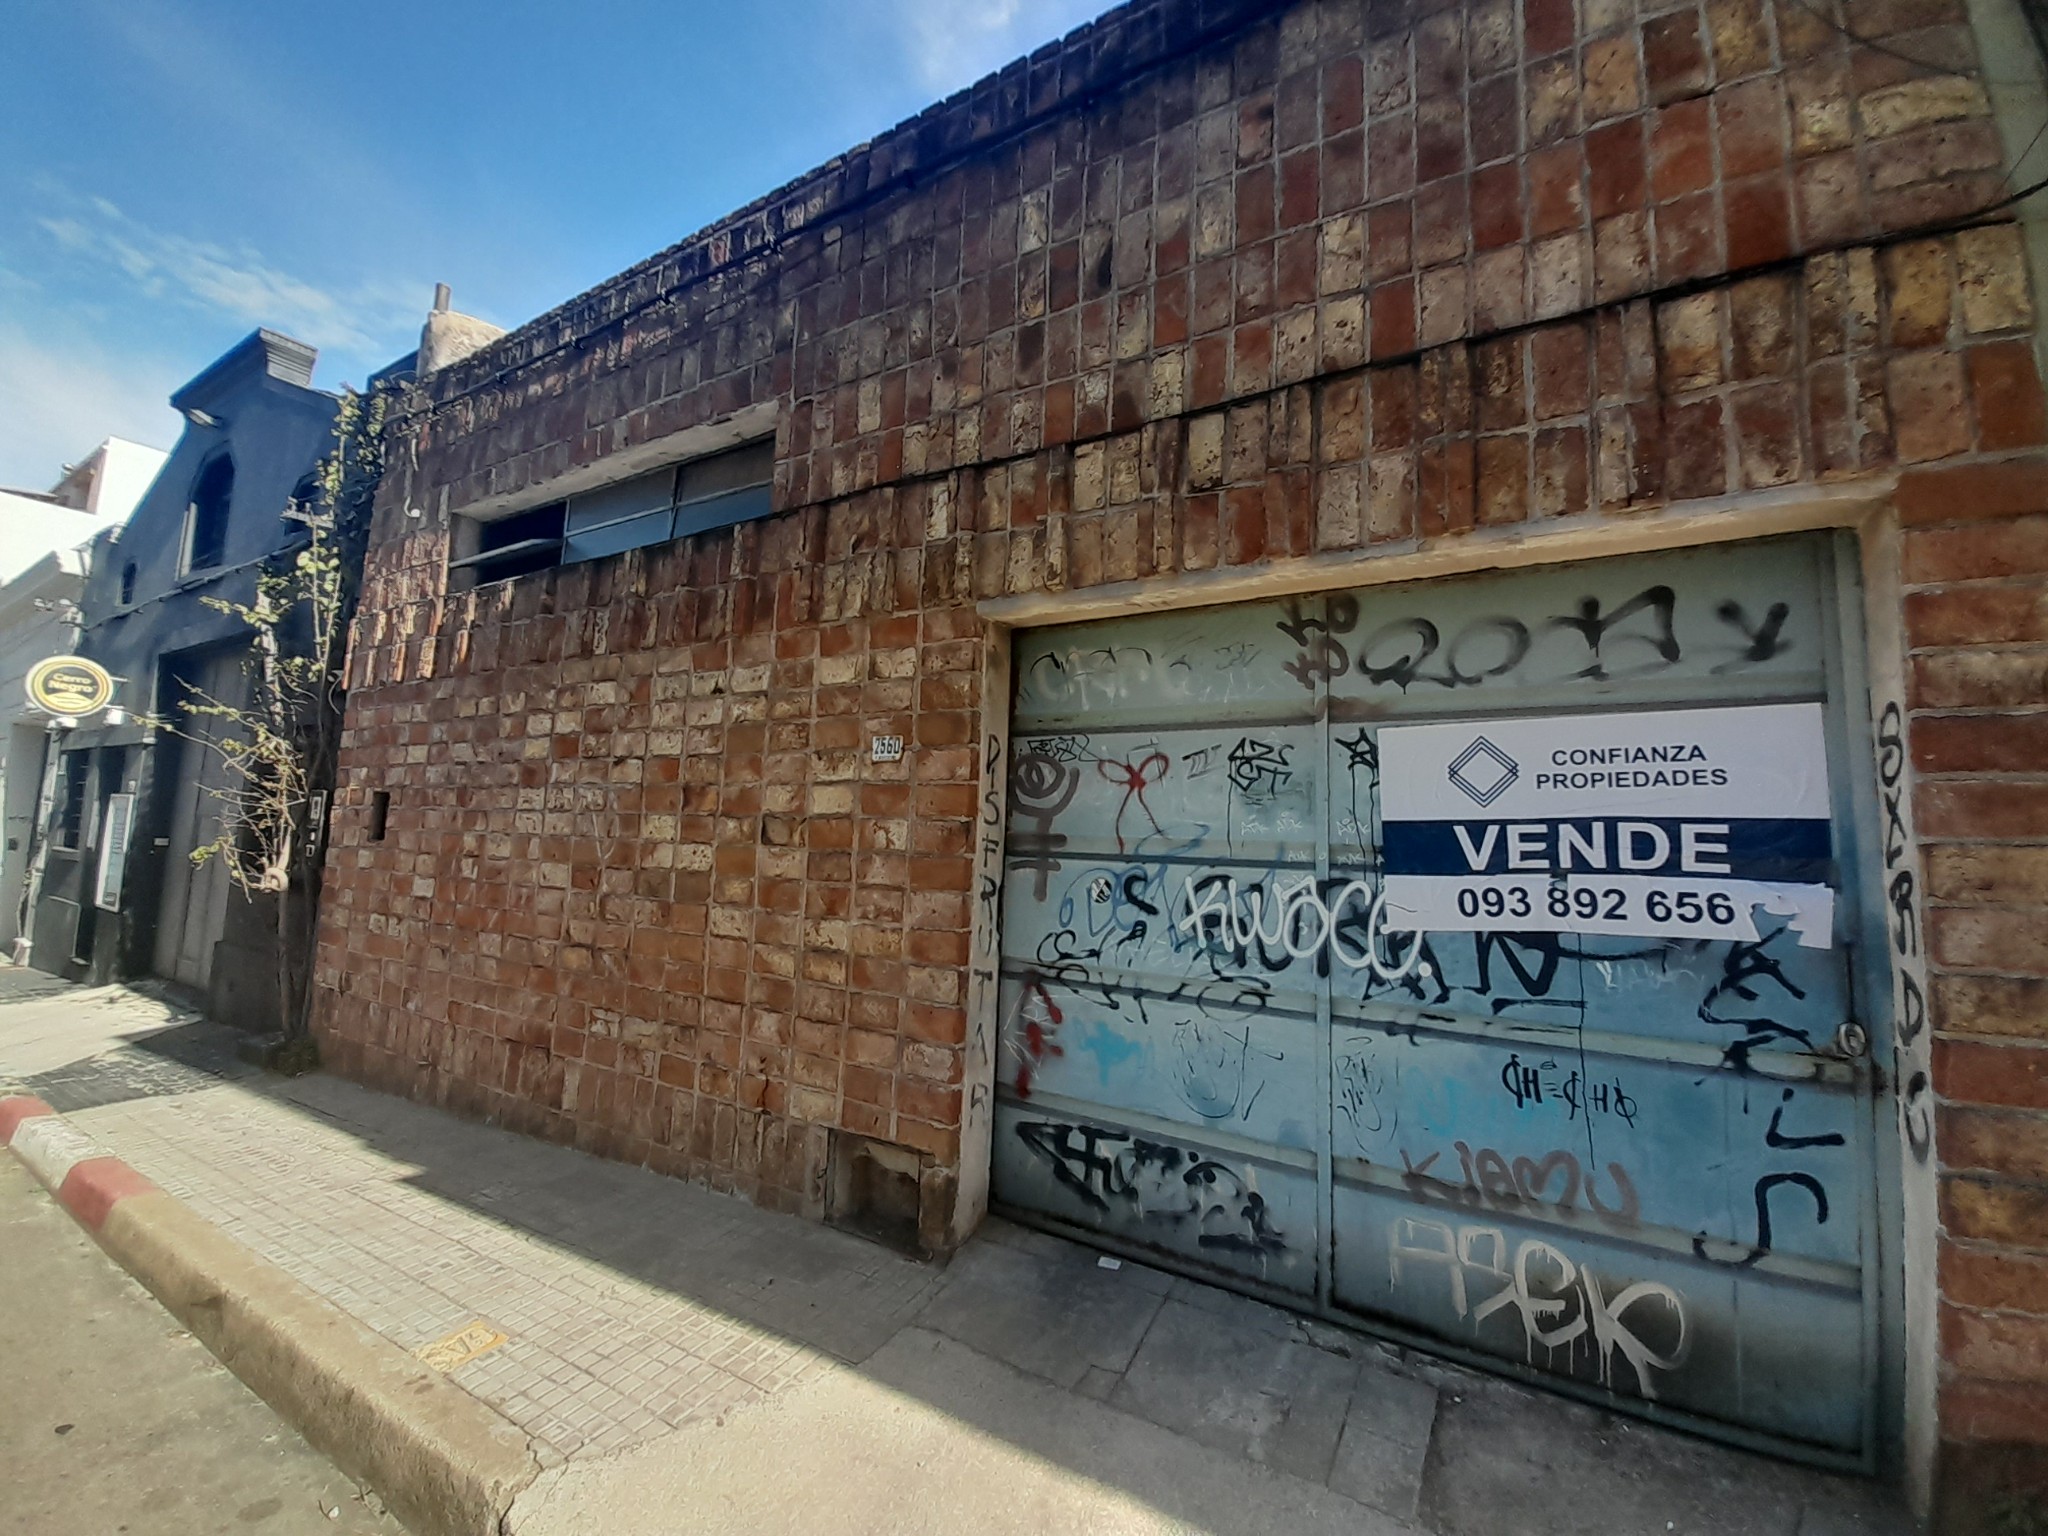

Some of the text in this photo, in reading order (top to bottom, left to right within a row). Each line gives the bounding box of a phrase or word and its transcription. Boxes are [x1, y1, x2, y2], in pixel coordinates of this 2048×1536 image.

[48, 680, 94, 692] Negro
[53, 673, 92, 684] Cerro
[874, 736, 900, 755] 2560
[1551, 744, 1708, 767] CONFIANZA
[1535, 768, 1729, 790] PROPIEDADES
[1453, 821, 1732, 874] VENDE
[1457, 887, 1736, 925] 093 892 656
